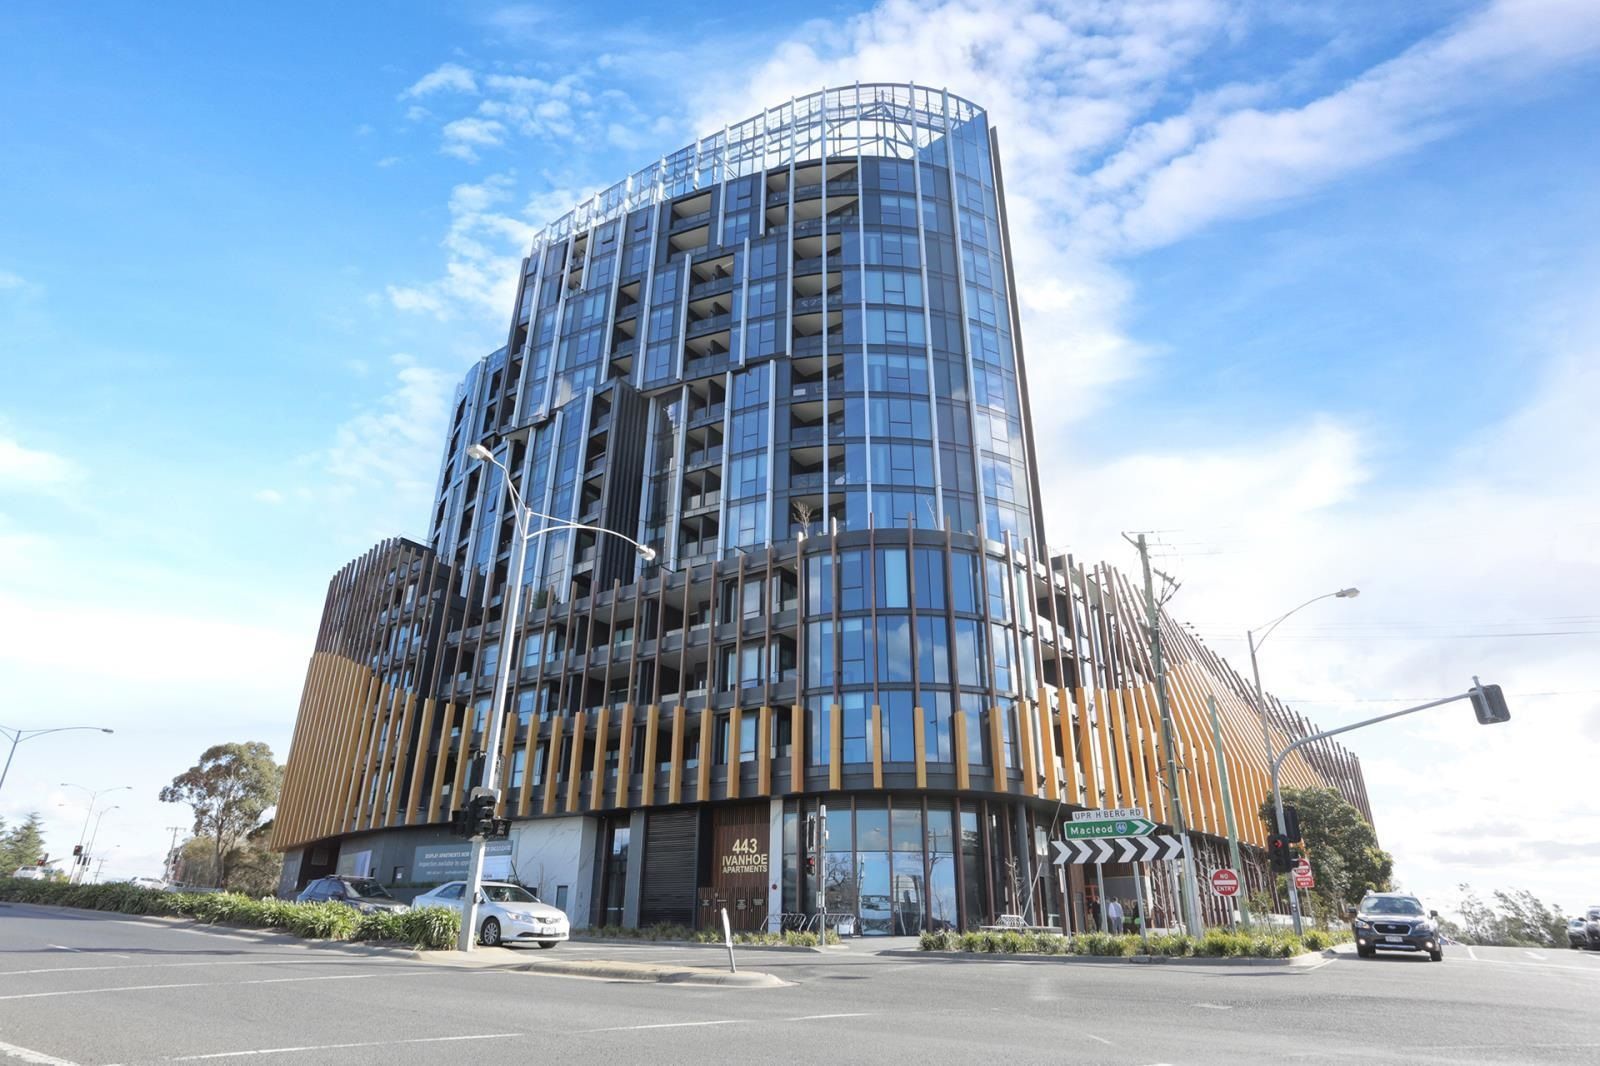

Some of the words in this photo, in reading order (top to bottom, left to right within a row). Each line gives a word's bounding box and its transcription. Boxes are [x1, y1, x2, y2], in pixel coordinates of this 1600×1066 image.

[1074, 811, 1092, 820] UPR
[1129, 808, 1141, 817] RD
[1070, 825, 1113, 836] Macleod
[732, 838, 758, 854] 443
[722, 854, 768, 866] IVANHOE
[722, 865, 768, 874] APARTMENTS
